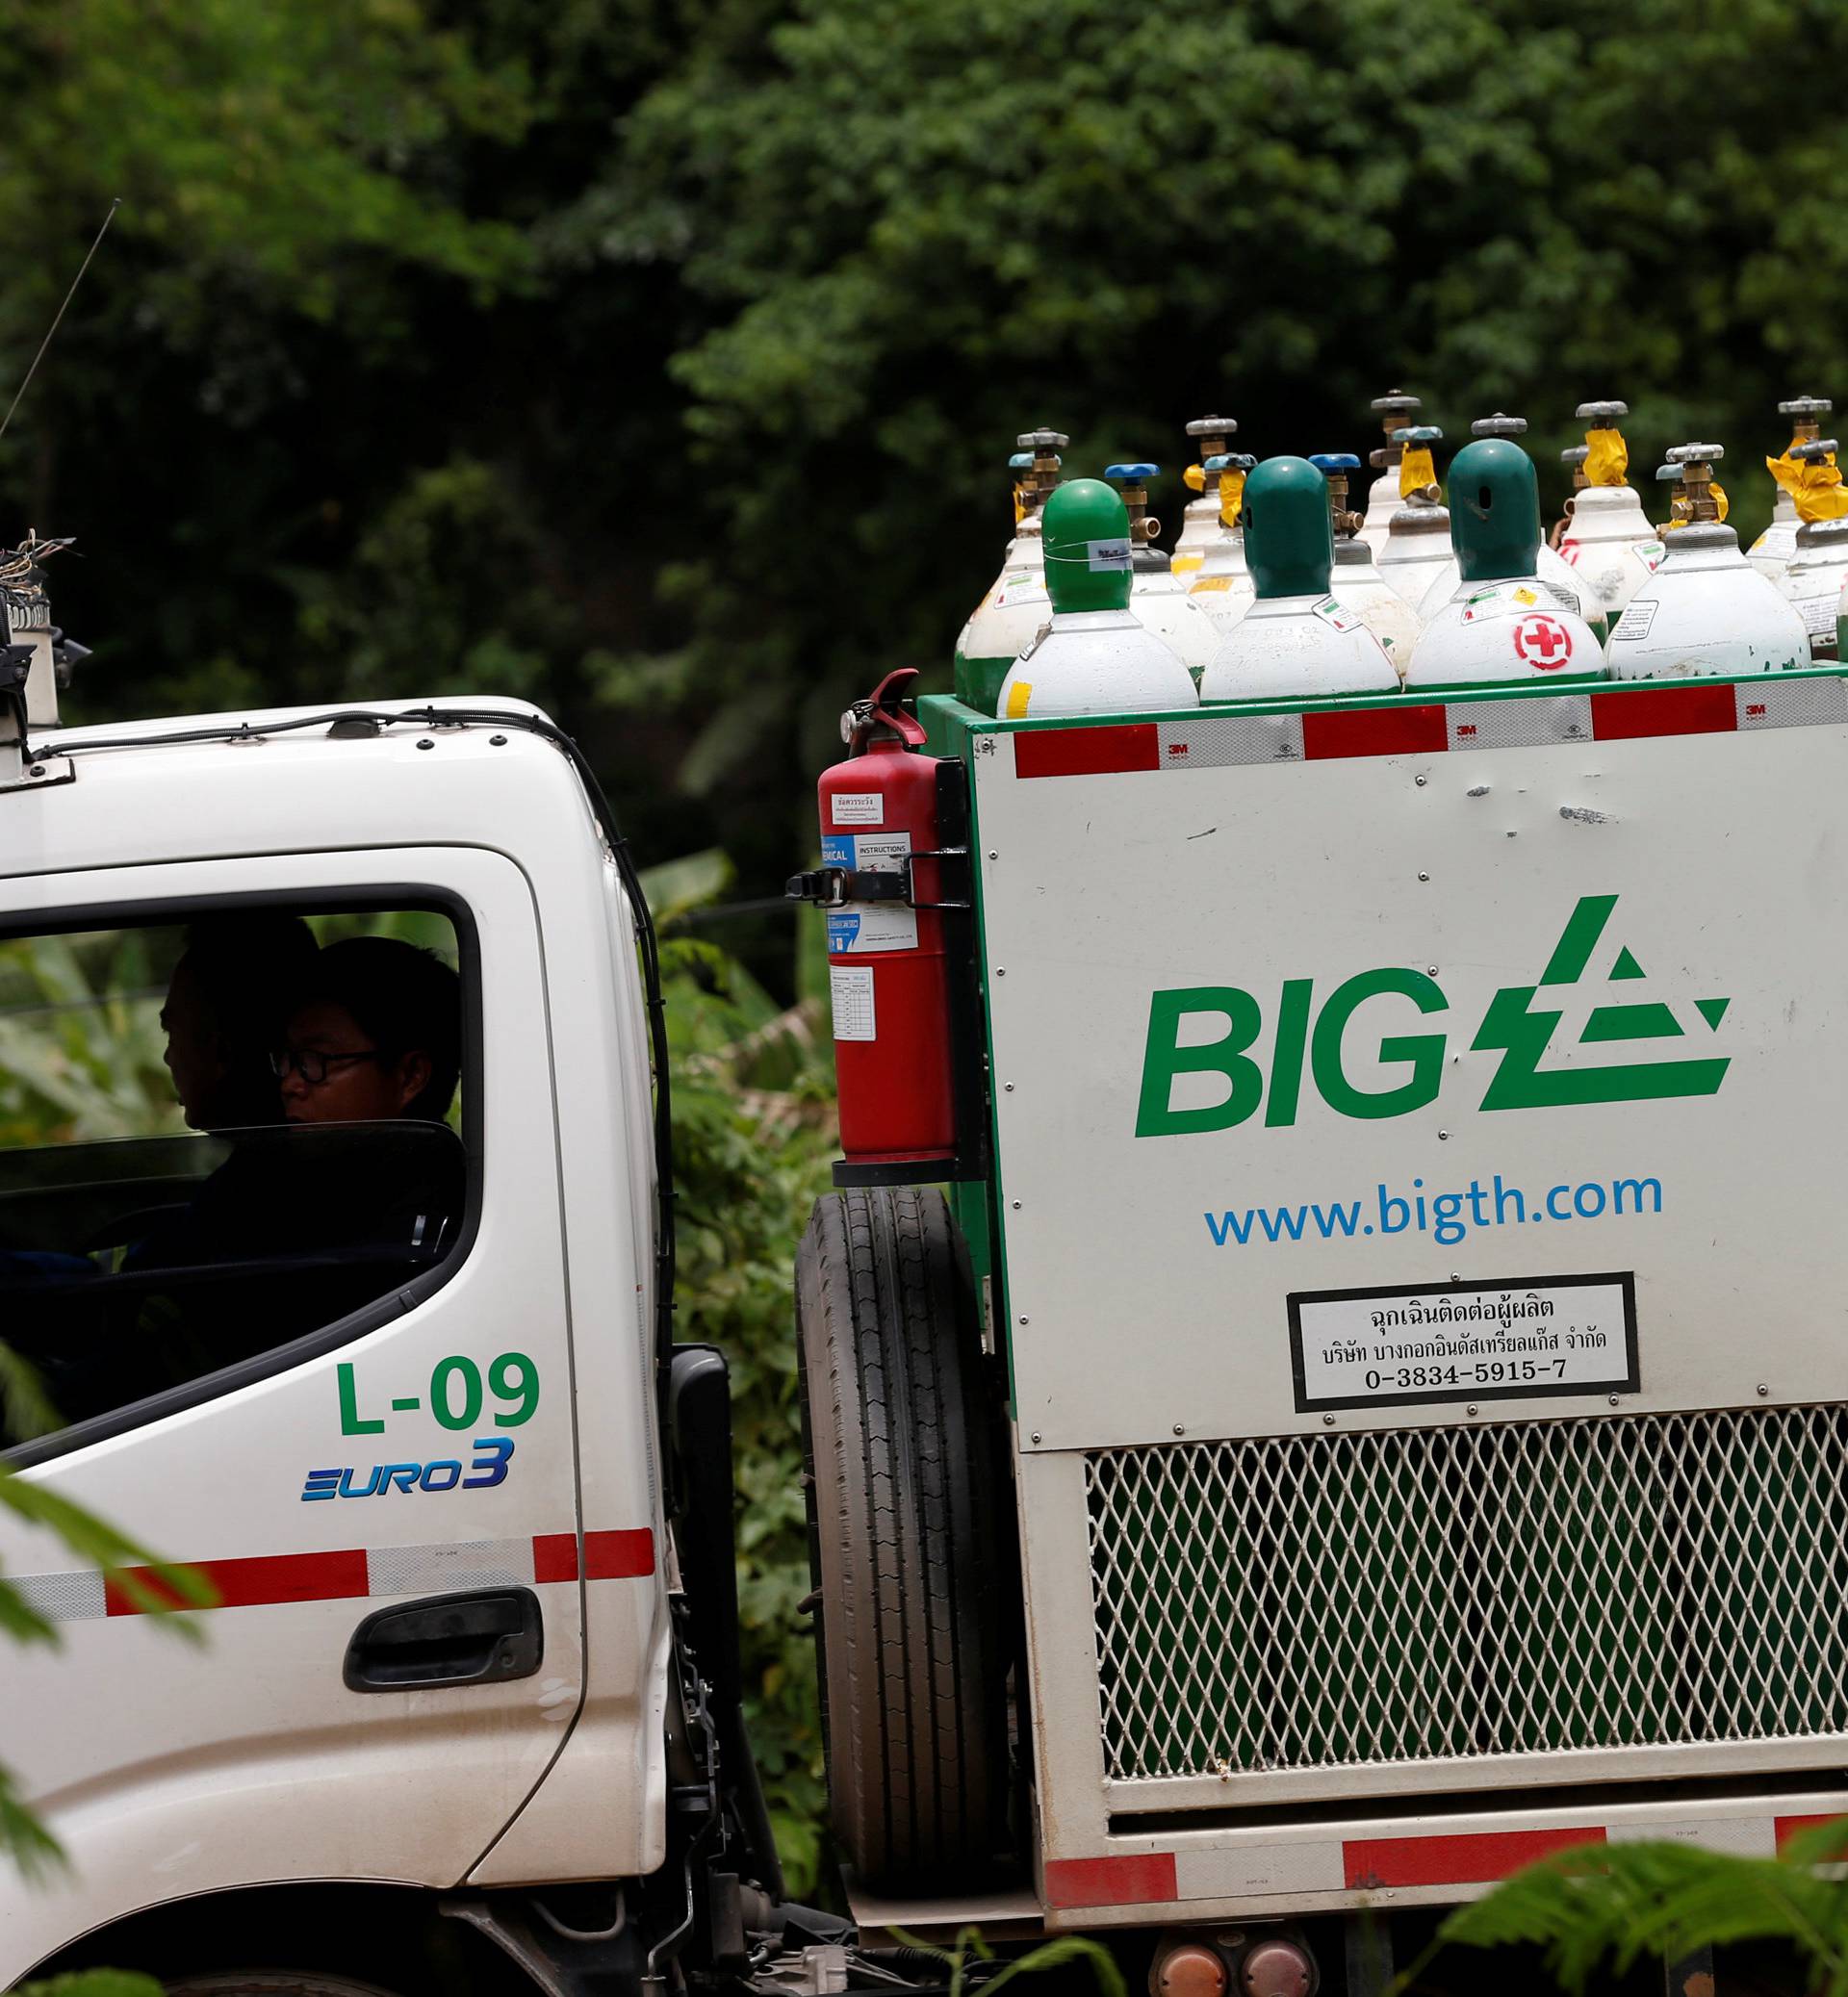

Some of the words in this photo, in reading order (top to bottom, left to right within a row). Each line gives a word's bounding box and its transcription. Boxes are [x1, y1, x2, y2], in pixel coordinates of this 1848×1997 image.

[1746, 704, 1766, 715] 3M
[1456, 725, 1476, 736] 3M
[1168, 744, 1188, 755] 3M
[860, 845, 907, 855] INSTRUCTIONS
[1135, 967, 1450, 1139] BIG
[1204, 1174, 1663, 1246] www.bigth.com
[1370, 1293, 1555, 1337] ฉุกเฉินติดต่อผู้ผลิต
[1322, 1339, 1367, 1365] บริษัท
[1373, 1326, 1559, 1361] บางกอกอินดัสเทรียลแก๊ส
[1566, 1324, 1606, 1350] จำกัด
[1365, 1358, 1567, 1390] 0-3834-5915-7
[337, 1352, 540, 1436] L-09
